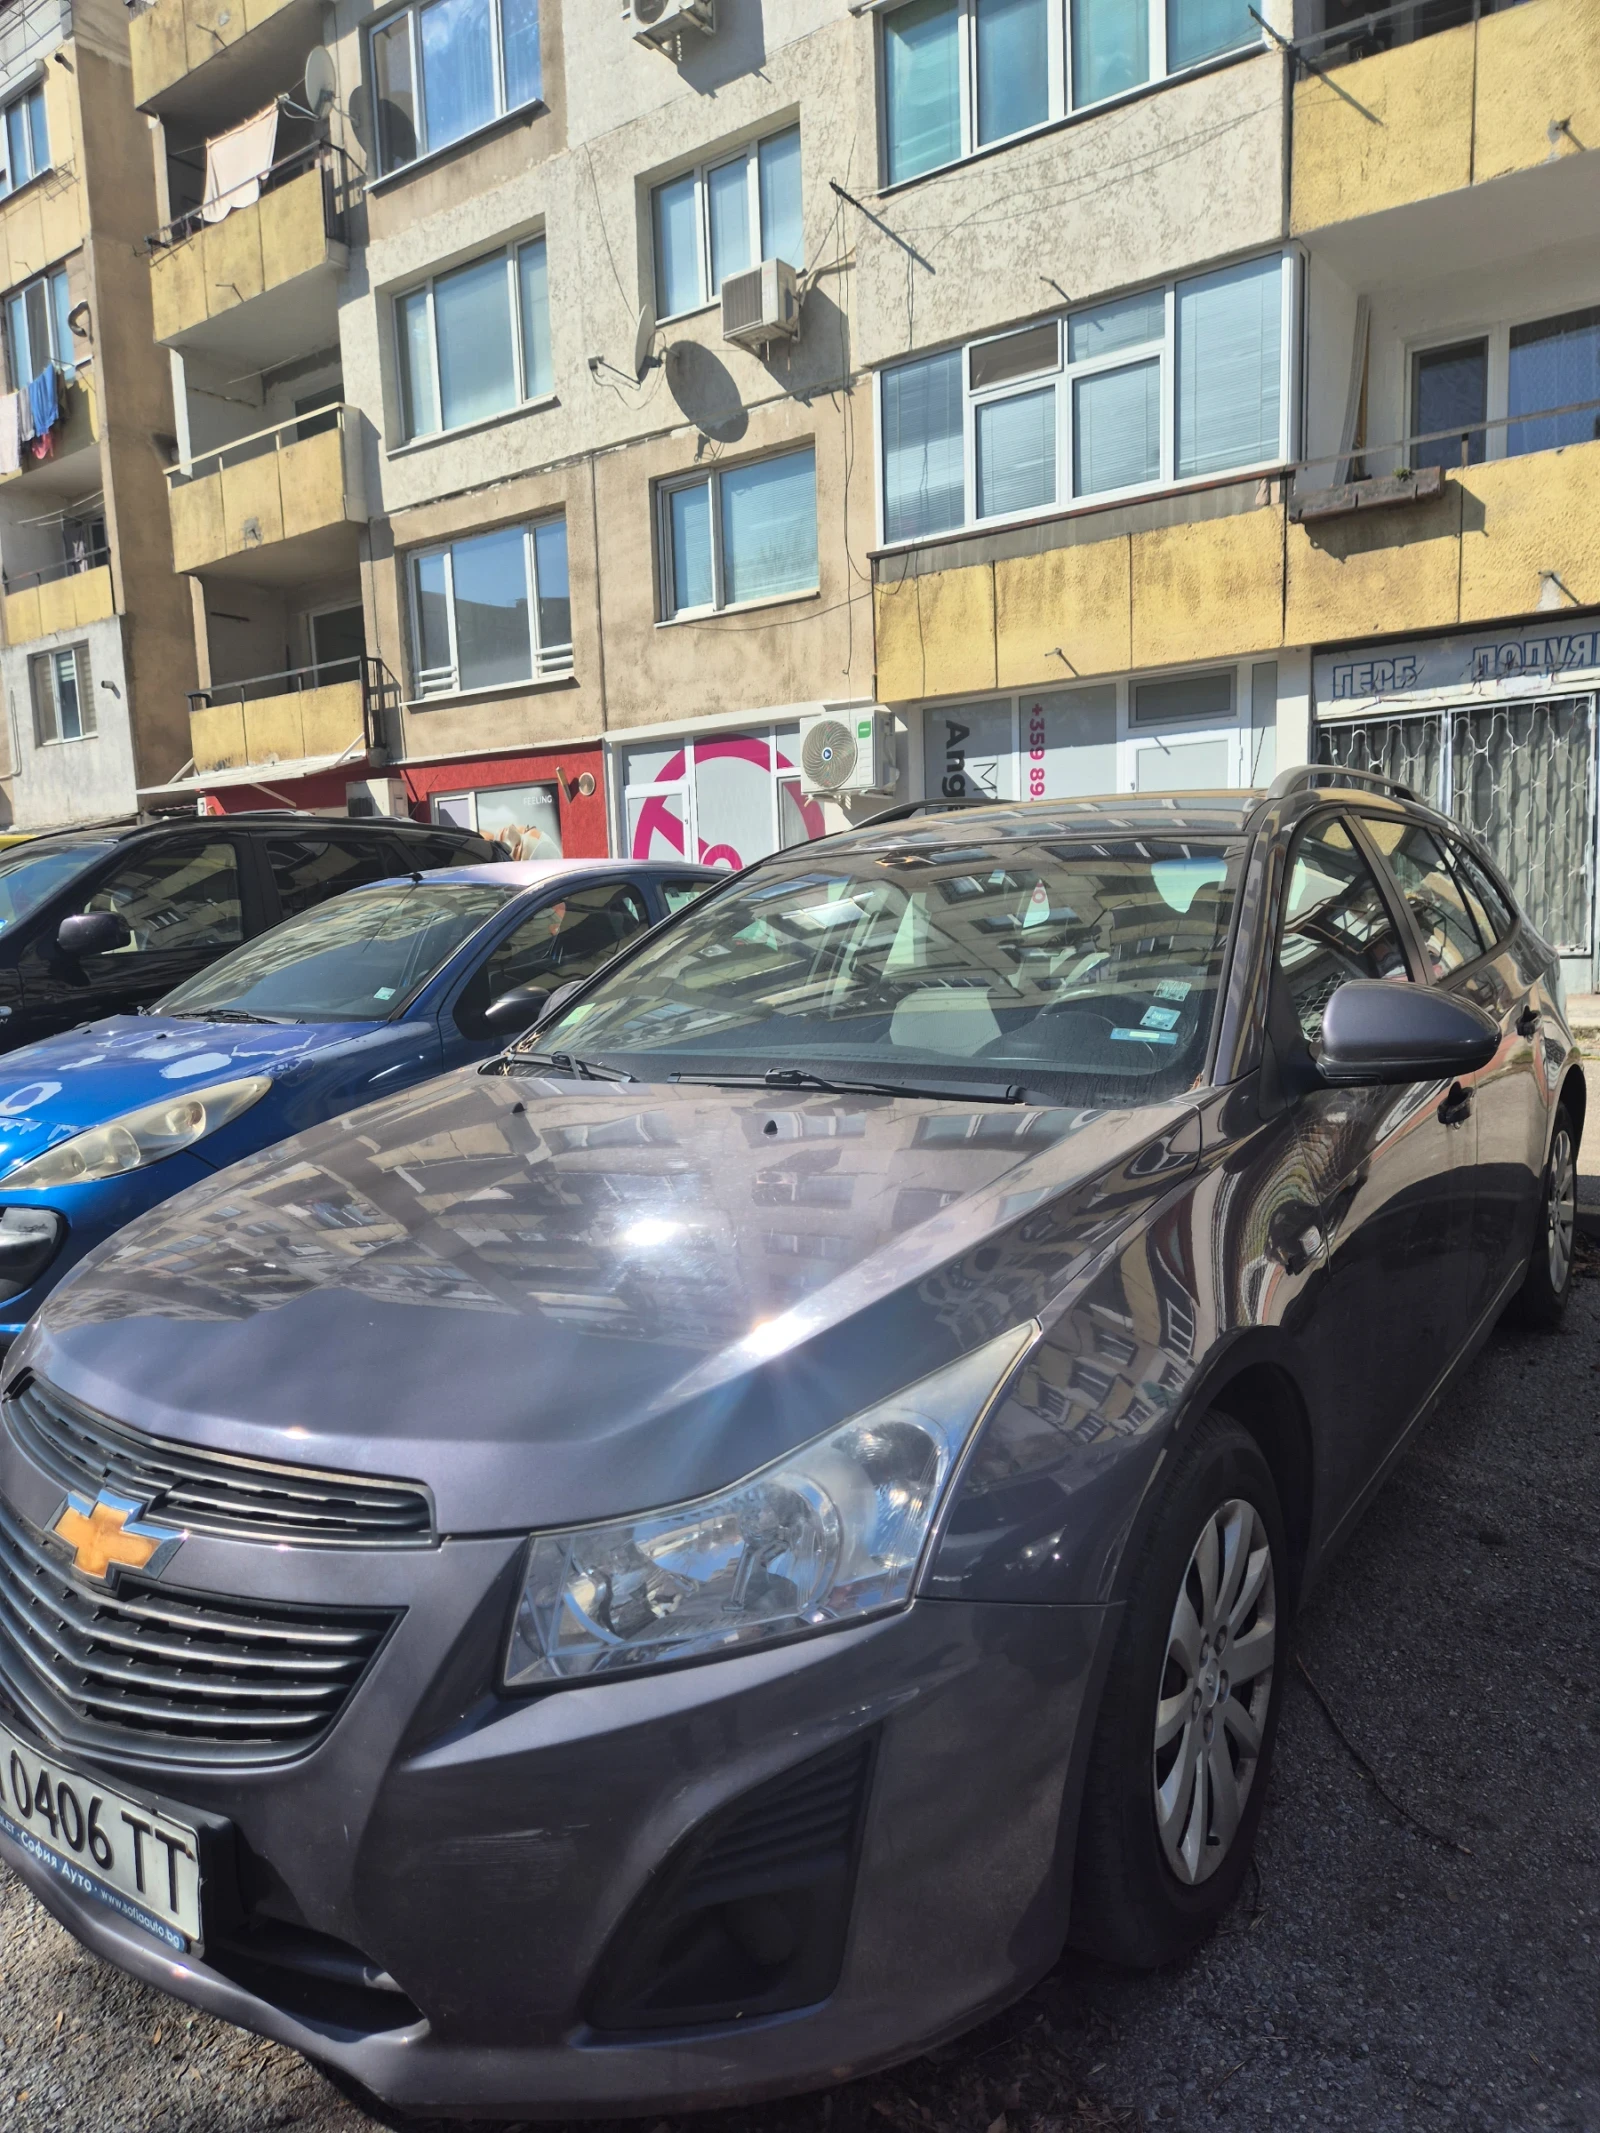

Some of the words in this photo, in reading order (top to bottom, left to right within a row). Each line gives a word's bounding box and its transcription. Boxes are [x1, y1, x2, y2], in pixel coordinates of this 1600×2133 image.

[1333, 656, 1417, 698] ГЕРБ
[1471, 631, 1600, 681] ПОДУЯ
[942, 720, 970, 805] Ang
[1029, 703, 1045, 760] +359
[523, 794, 553, 805] FEELING
[1029, 768, 1045, 802] 89
[10, 1749, 114, 1871] 0406
[121, 1809, 196, 1915] TT
[20, 1830, 58, 1869] София
[100, 1888, 181, 1950] www.sofiaauto.bg
